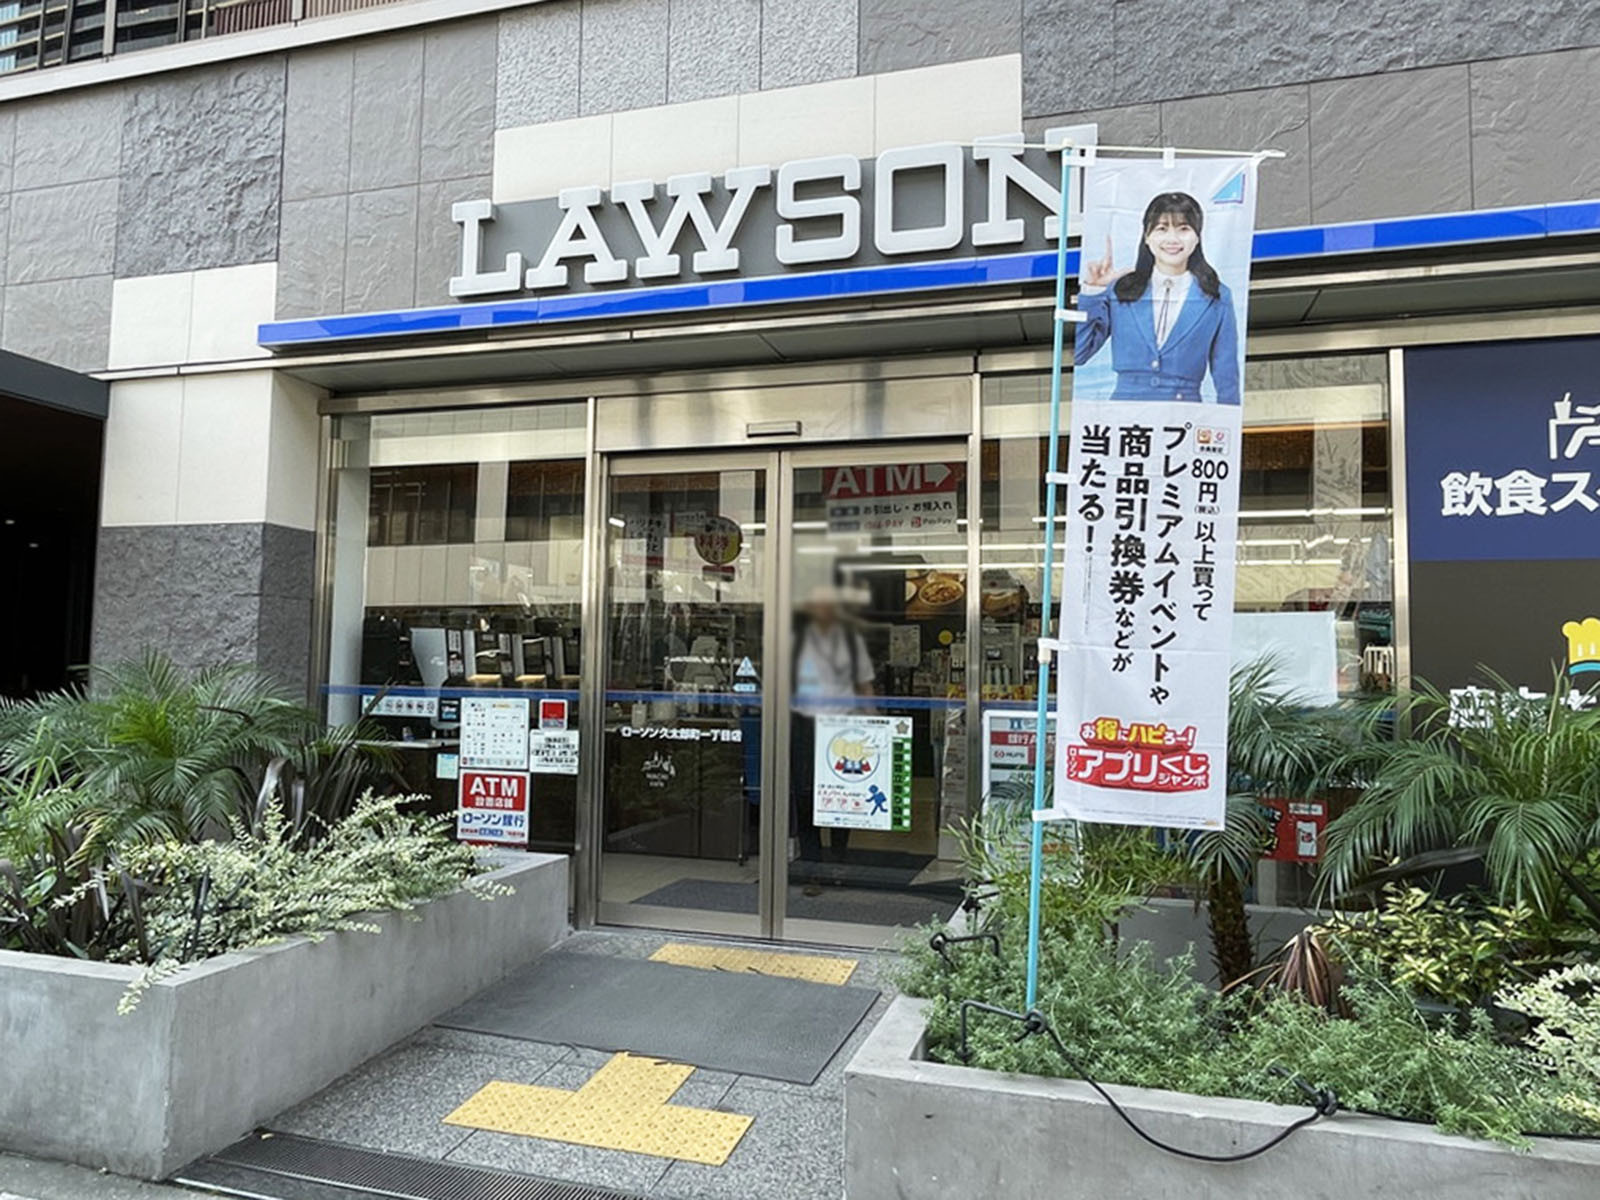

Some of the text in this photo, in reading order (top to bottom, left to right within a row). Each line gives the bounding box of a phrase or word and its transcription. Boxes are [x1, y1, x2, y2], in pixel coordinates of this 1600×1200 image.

[450, 123, 1098, 298] LAWSON
[829, 463, 922, 497] ATM
[1078, 424, 1111, 553] 当たる！
[1441, 470, 1600, 517] 飲食ス
[1107, 424, 1154, 673] 商品引換券などが
[1149, 421, 1193, 706] プレミアムイベントや
[621, 726, 743, 742] ローソン久太郎町一丁目店
[1082, 718, 1194, 746] お得にハピろー！
[1077, 748, 1207, 784] アプリくじ
[469, 776, 519, 797] ATM
[462, 813, 524, 828] ローソン銀行
